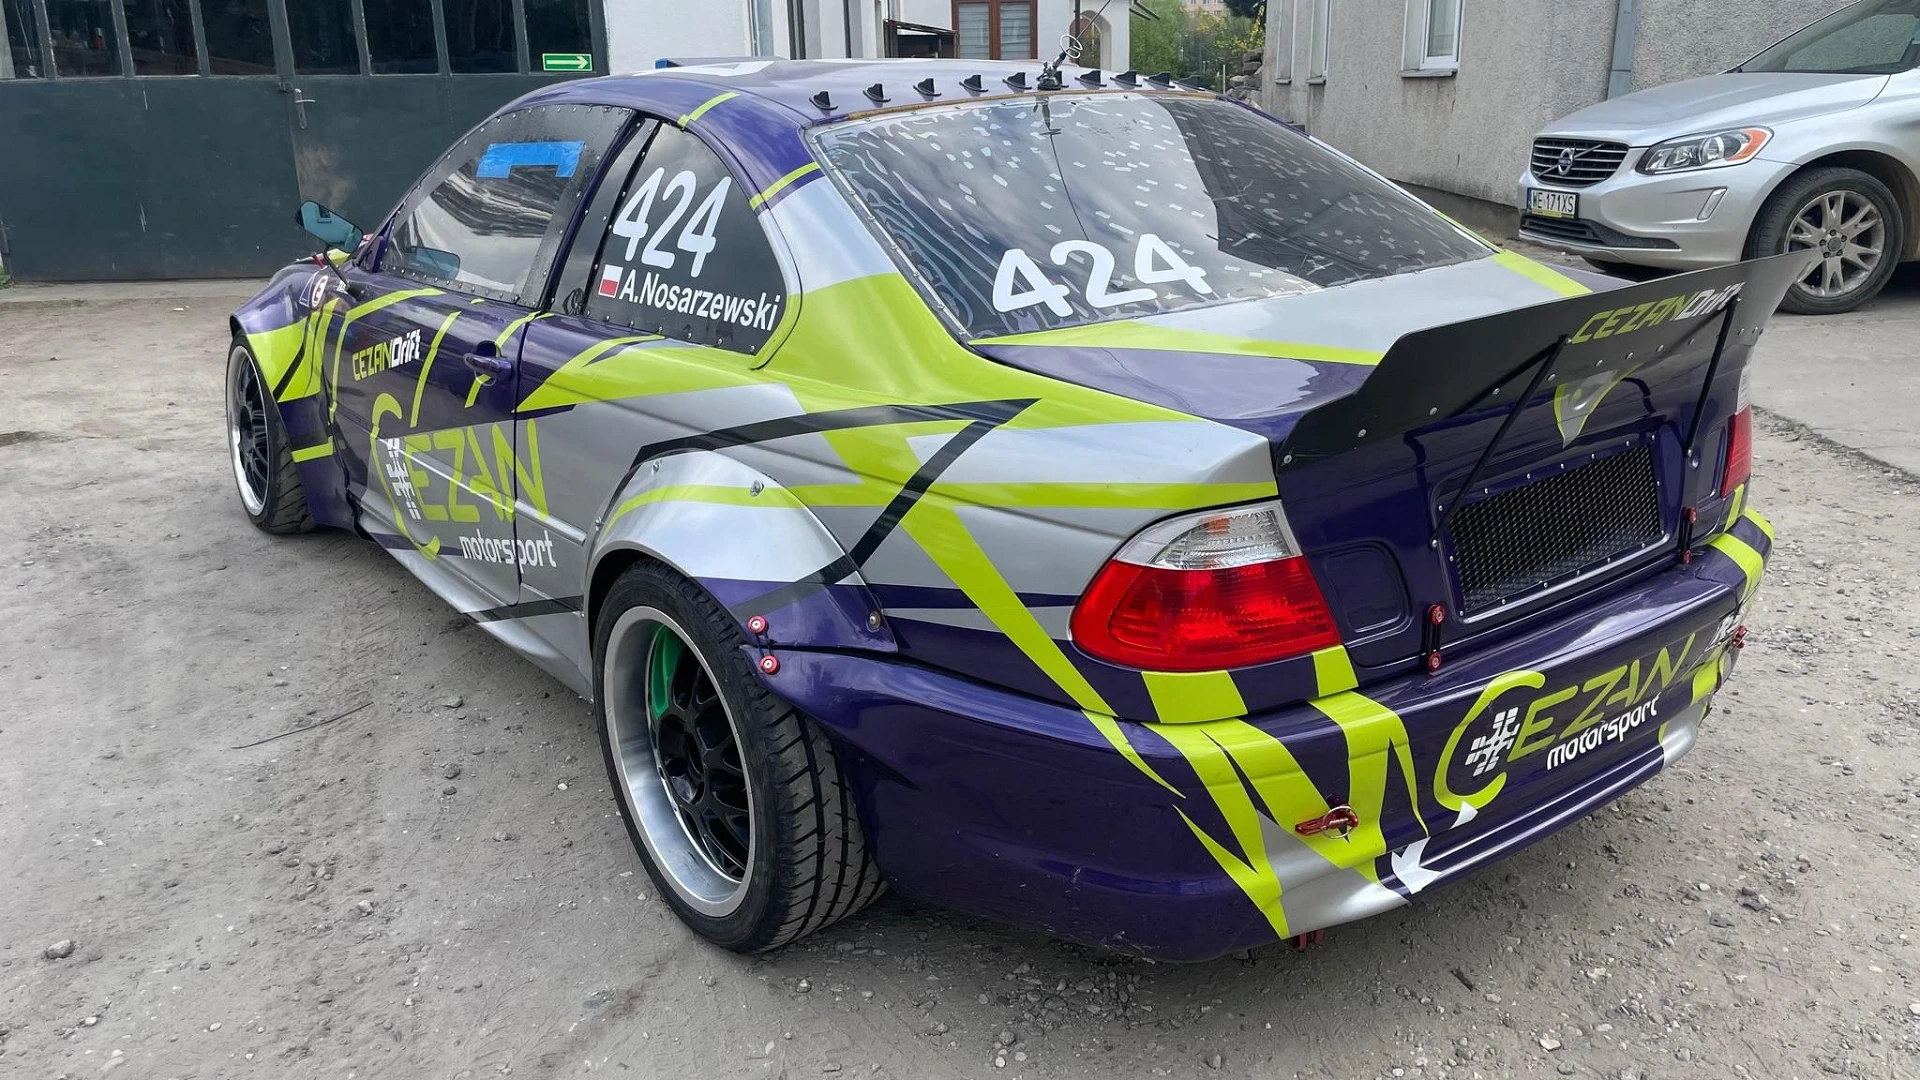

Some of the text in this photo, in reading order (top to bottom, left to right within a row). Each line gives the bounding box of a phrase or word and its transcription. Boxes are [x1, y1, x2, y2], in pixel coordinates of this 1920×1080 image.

[613, 167, 732, 278] 424
[619, 269, 781, 331] A.Nosarzewski
[993, 233, 1212, 317] 424
[370, 393, 549, 561] CEZAN
[459, 528, 557, 574] motorsport
[1433, 632, 1696, 812] CEZAN
[1547, 692, 1662, 771] motorsport
